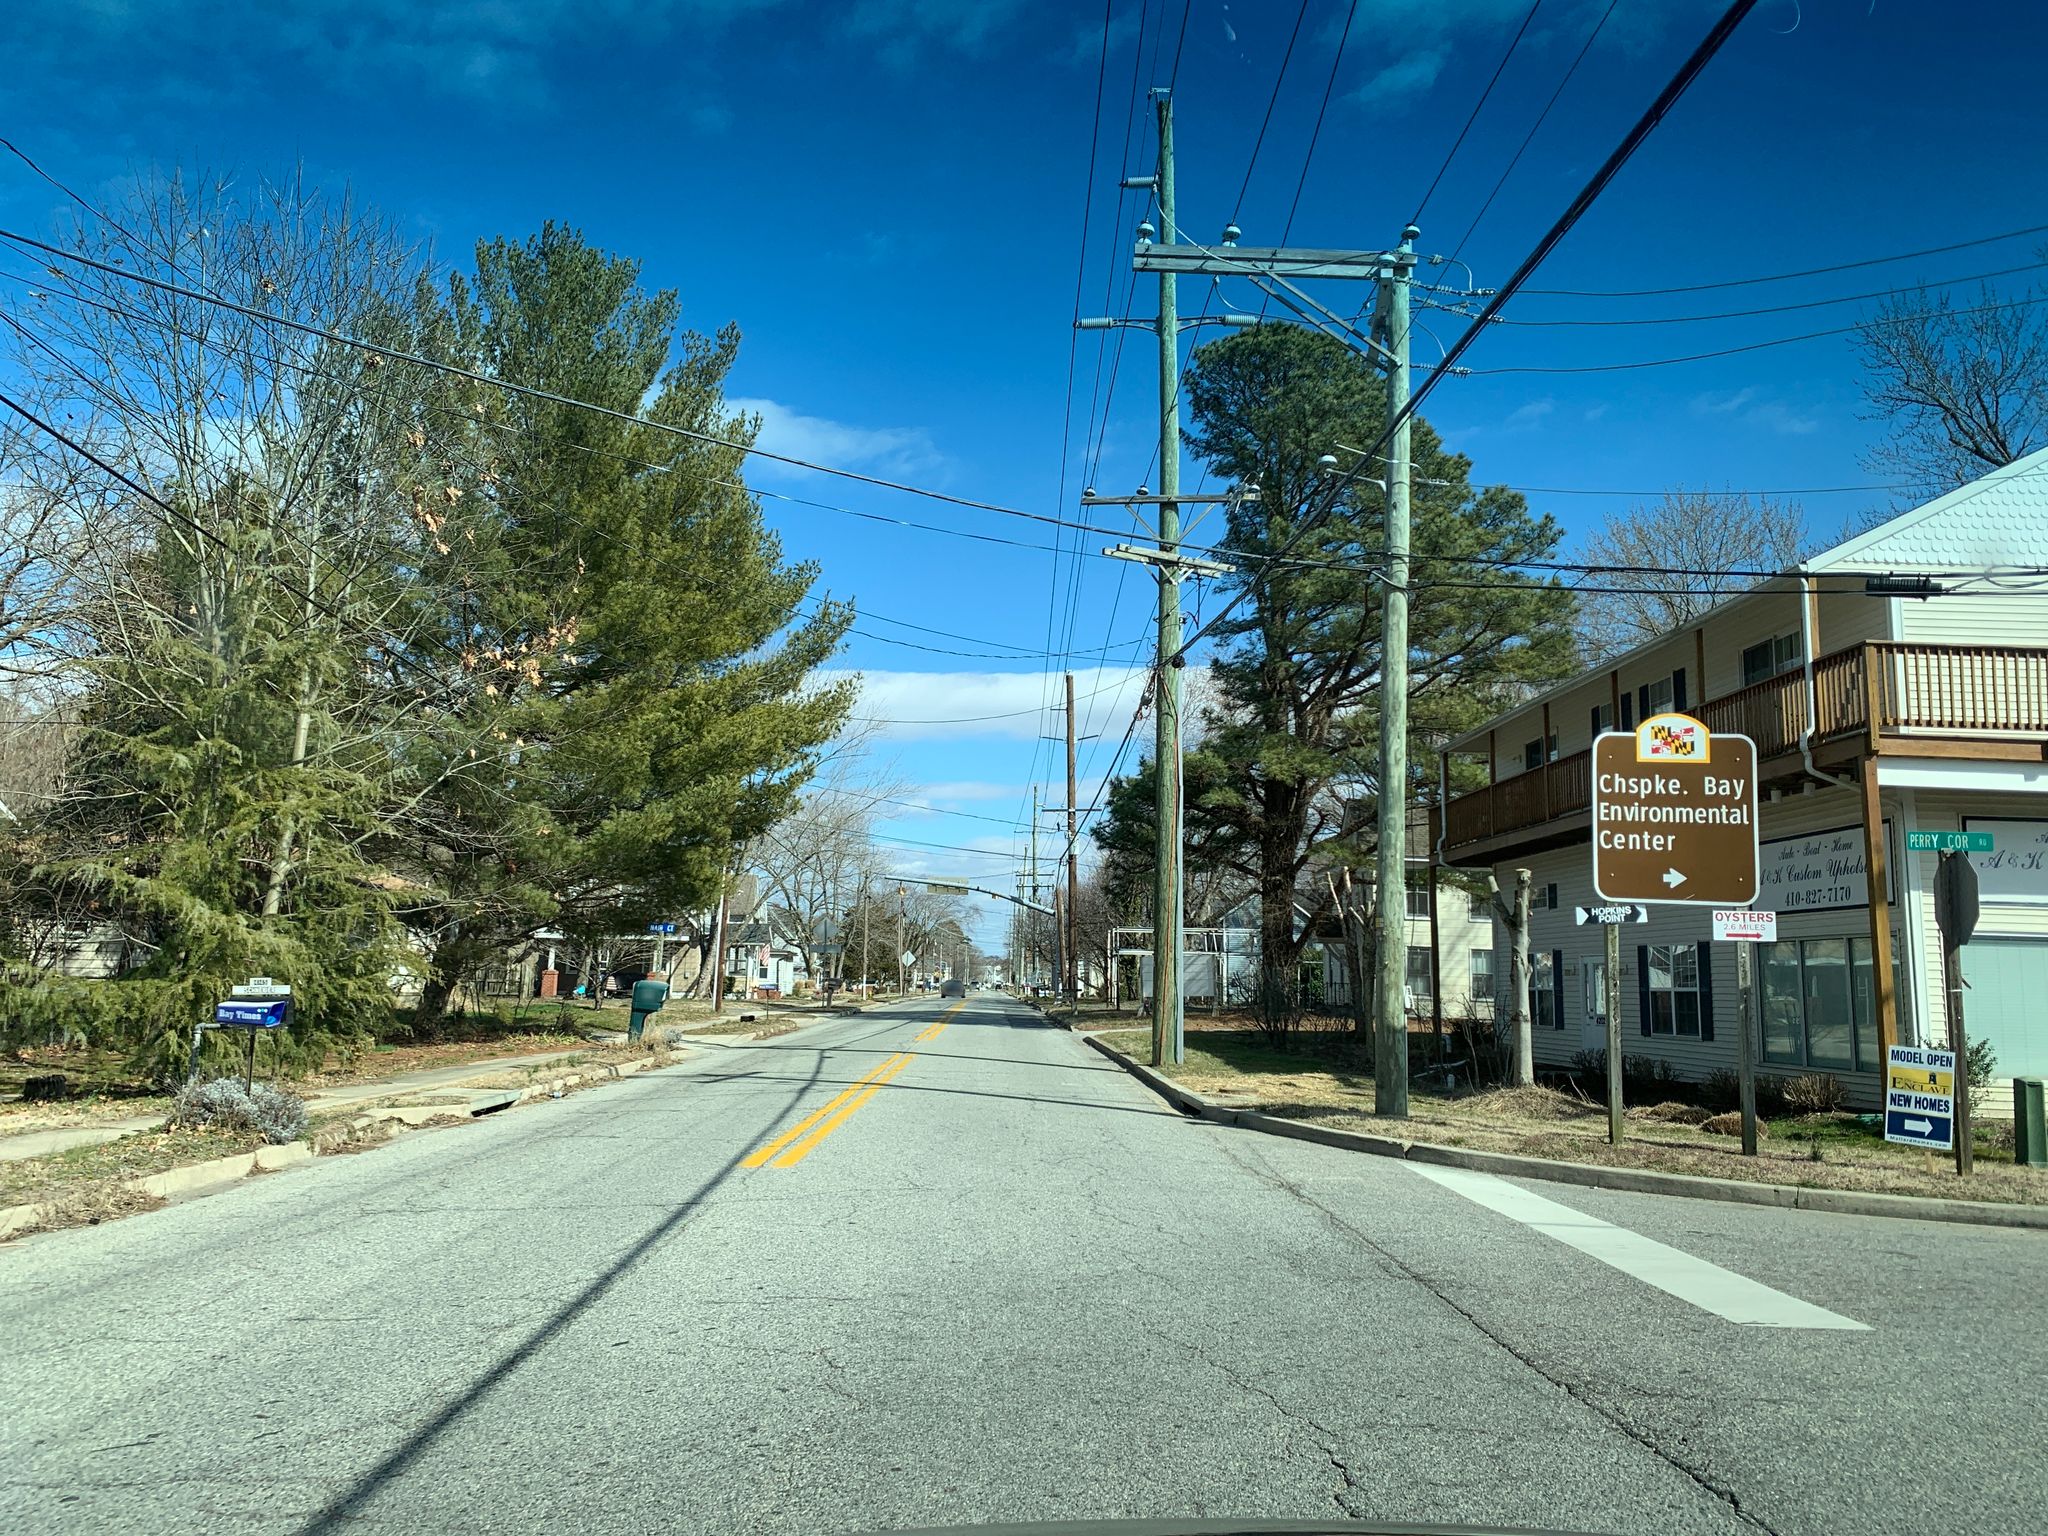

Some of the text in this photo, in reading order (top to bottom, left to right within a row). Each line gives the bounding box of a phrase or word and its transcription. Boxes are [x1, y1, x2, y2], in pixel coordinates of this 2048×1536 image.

[1600, 773, 1745, 800] Chspke. Bay
[1600, 802, 1750, 825] Environmental
[1600, 830, 1675, 851] Center
[1831, 837, 1853, 852] Home
[1910, 834, 1939, 848] PERRY
[1947, 834, 1969, 849] COR
[1786, 864, 1822, 883] Custom
[1785, 886, 1851, 906] 410-827-7170
[1591, 906, 1632, 916] HOPKINS
[1598, 913, 1626, 923] POINT
[1715, 912, 1774, 922] OYSTERS
[1891, 1049, 1953, 1068] MODEL OPEN
[1892, 1076, 1950, 1095] ENCLAVE
[1890, 1093, 1950, 1113] NEW HOMES
